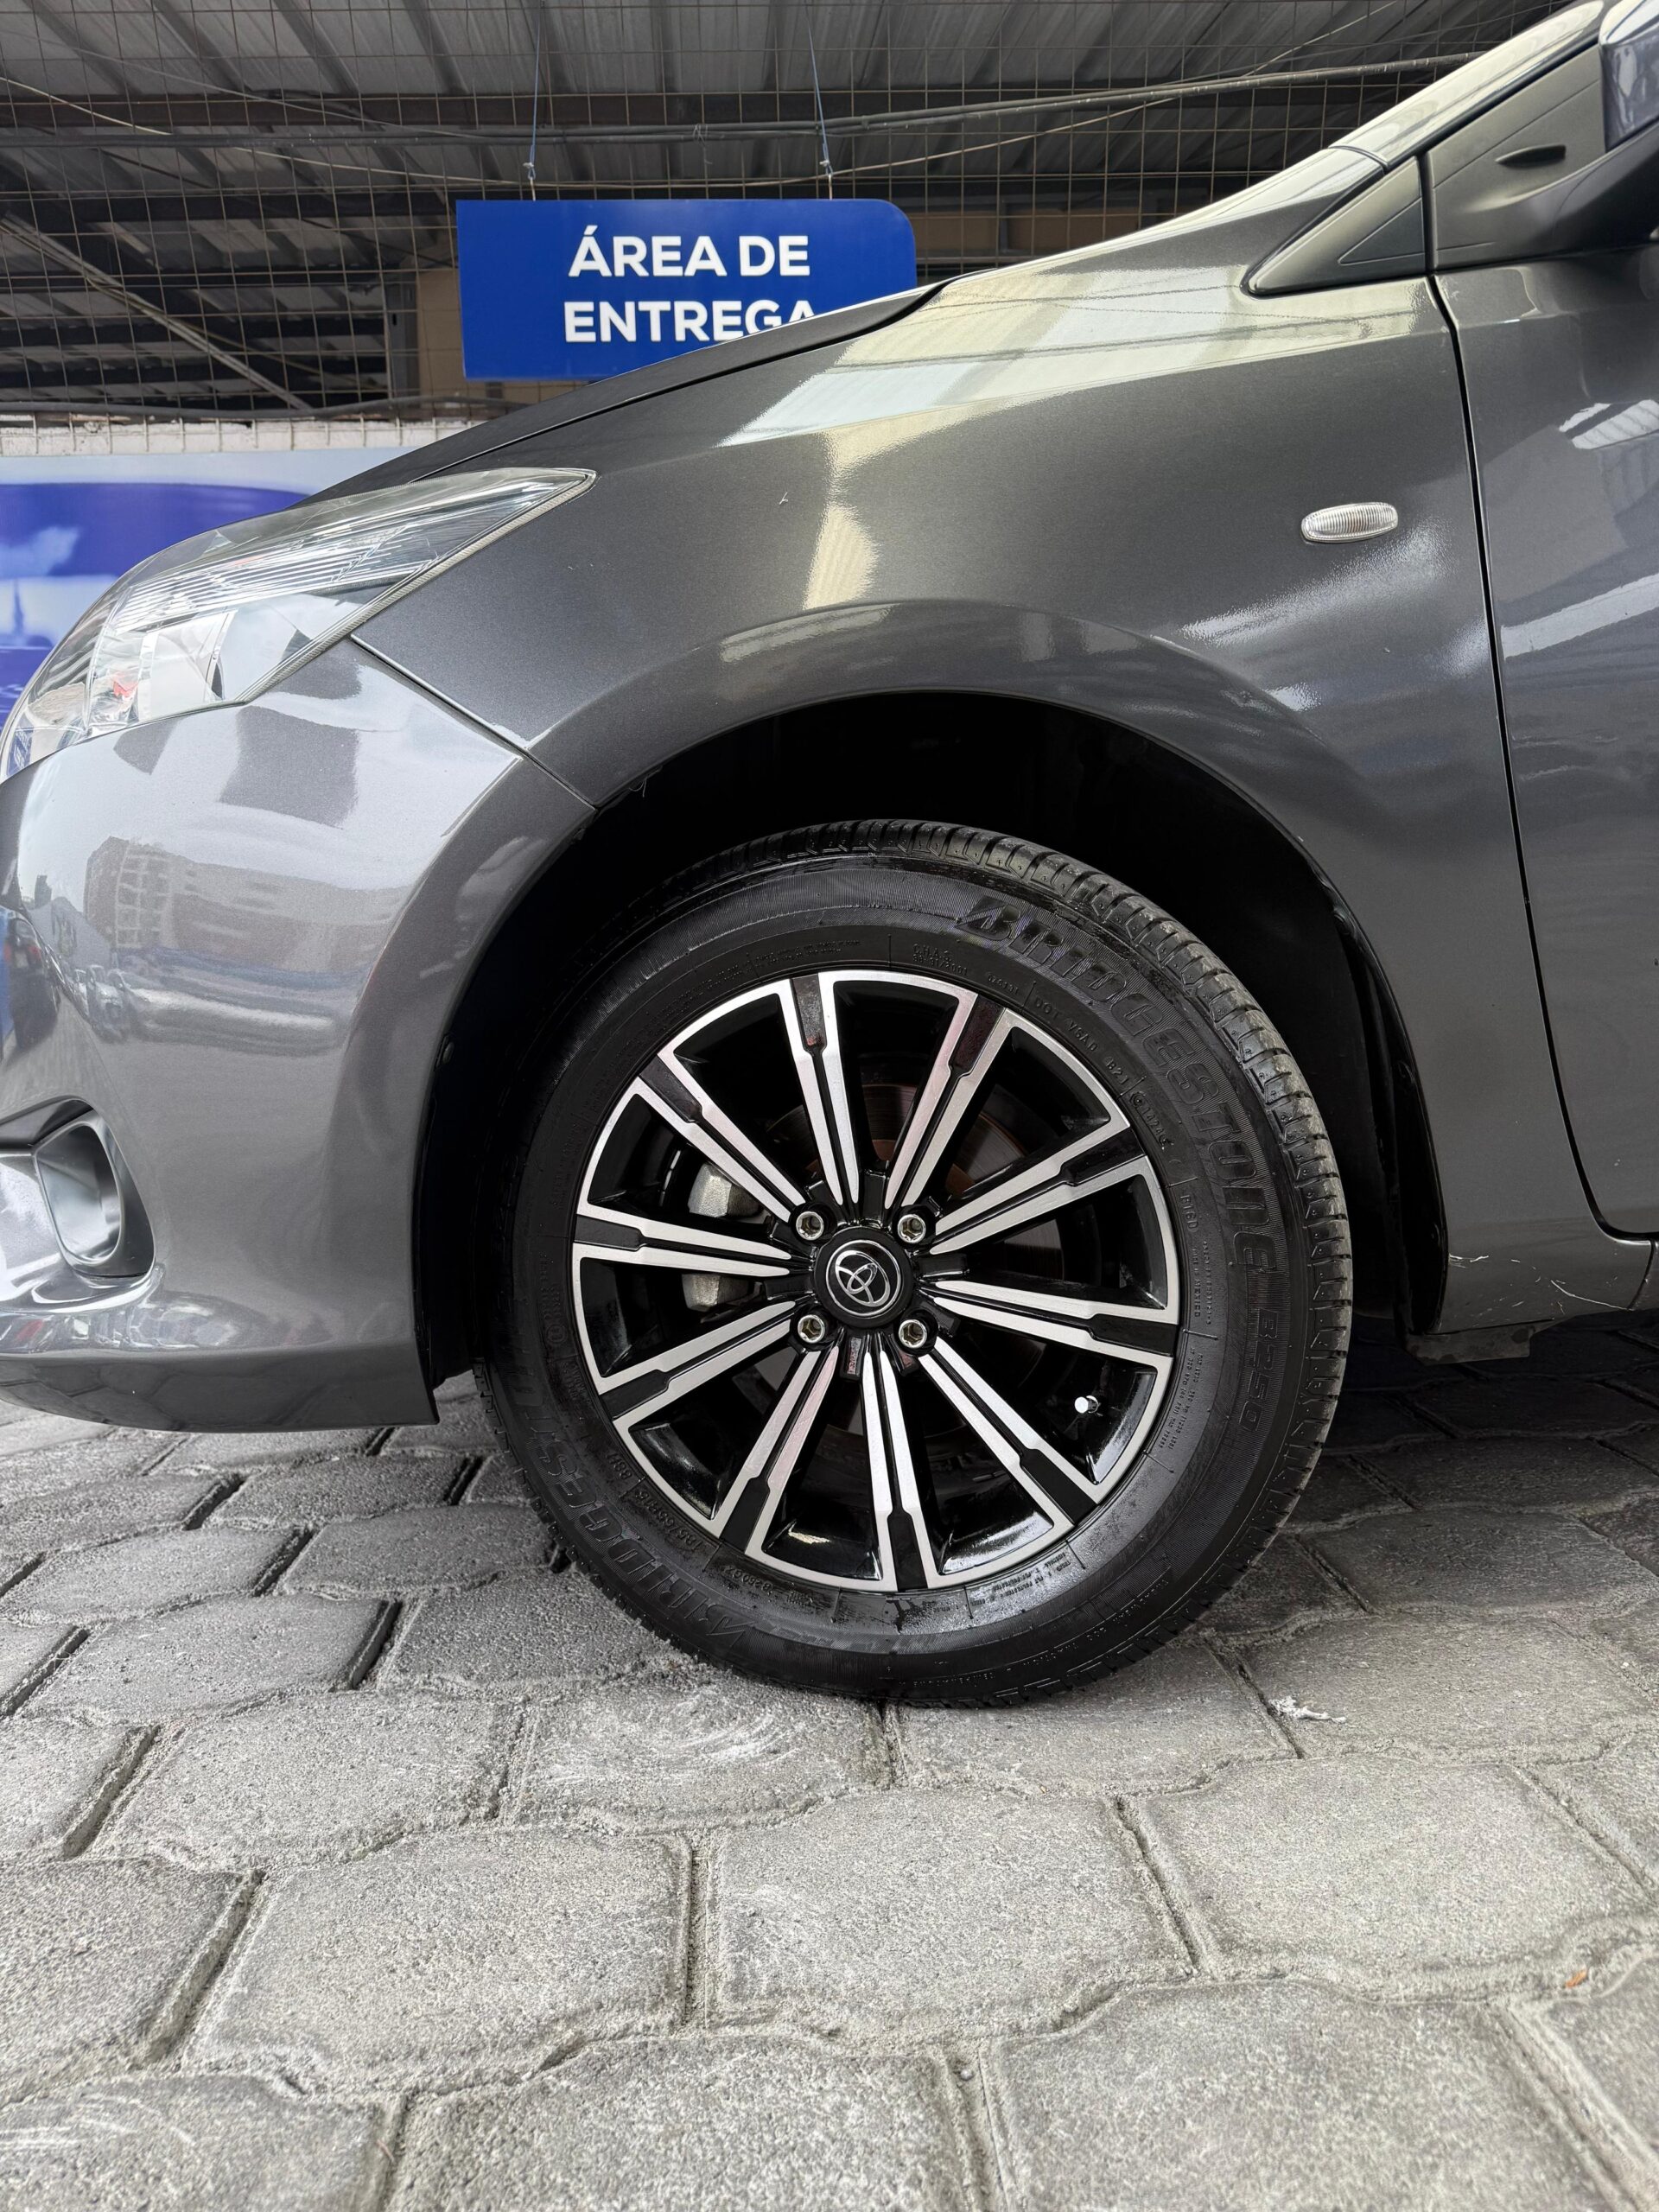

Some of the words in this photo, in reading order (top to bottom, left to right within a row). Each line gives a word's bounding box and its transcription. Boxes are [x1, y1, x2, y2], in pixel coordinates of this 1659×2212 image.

[569, 226, 727, 276] ÁREA
[740, 236, 810, 276] DE
[956, 895, 1276, 1269] BRIDGESTONE
[1238, 1308, 1279, 1431] B250
